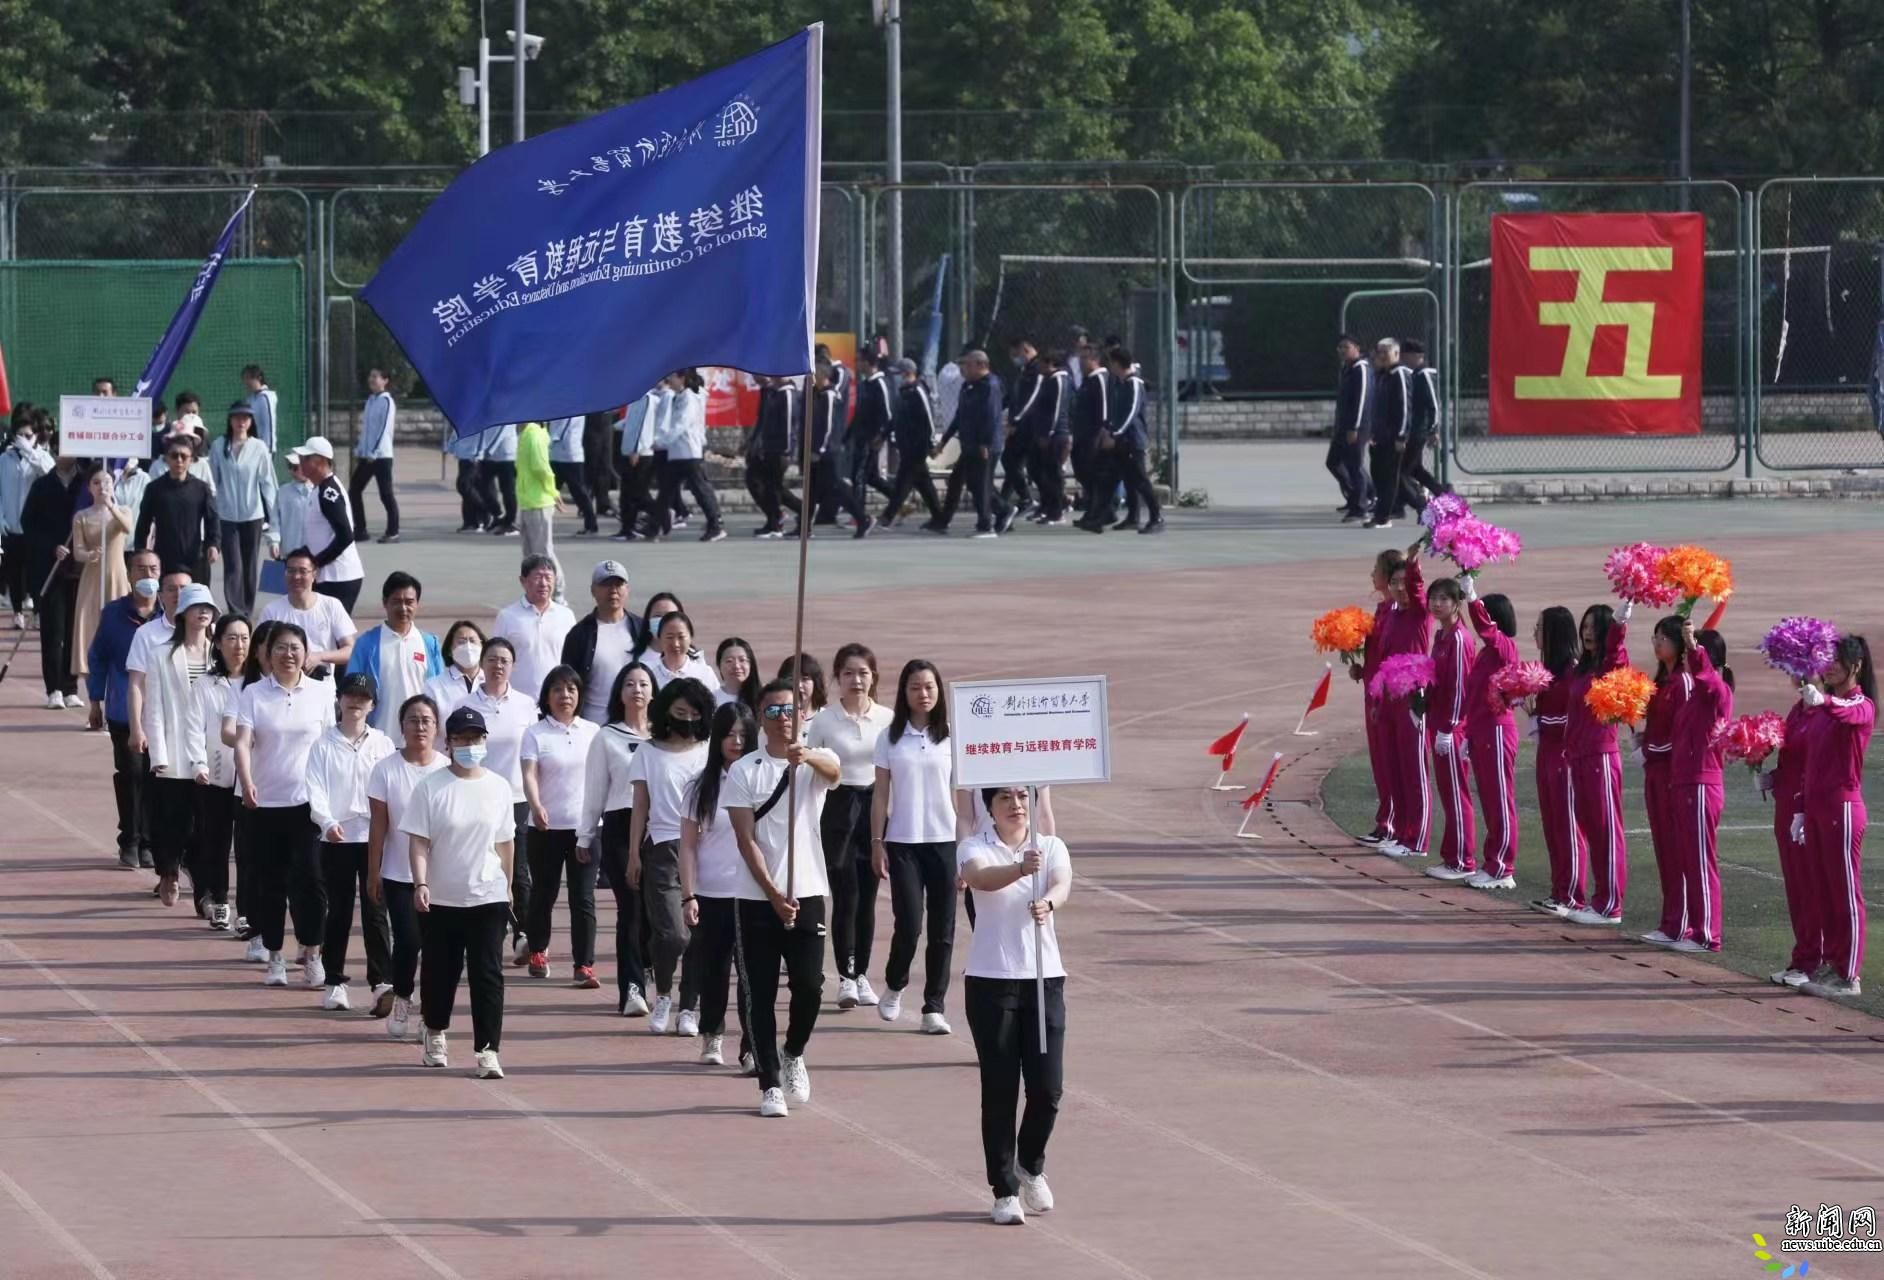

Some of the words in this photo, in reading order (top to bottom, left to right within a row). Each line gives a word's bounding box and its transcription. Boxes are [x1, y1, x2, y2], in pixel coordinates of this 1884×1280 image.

[1515, 246, 1682, 400] 五
[965, 738, 1097, 755] 继续教育与远程教育学院
